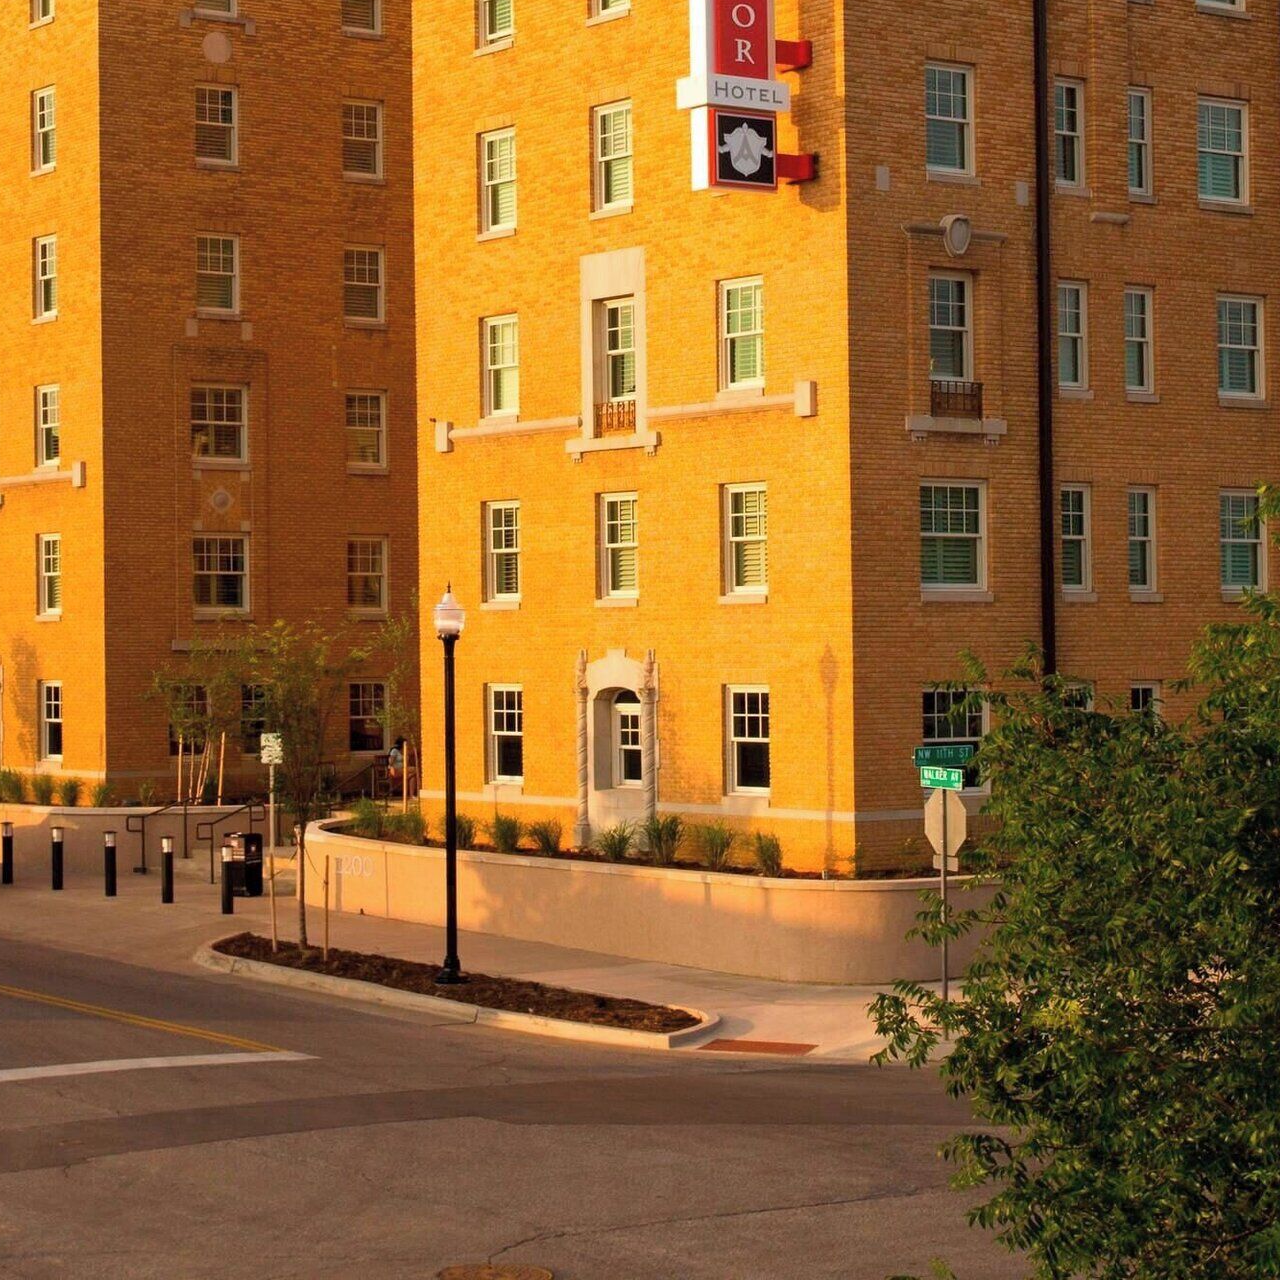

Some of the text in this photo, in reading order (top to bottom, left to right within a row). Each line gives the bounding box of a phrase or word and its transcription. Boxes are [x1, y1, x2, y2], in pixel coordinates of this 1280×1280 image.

[714, 80, 783, 104] HOTEL
[918, 748, 969, 759] NW 11TH ST
[923, 769, 948, 780] WALKER
